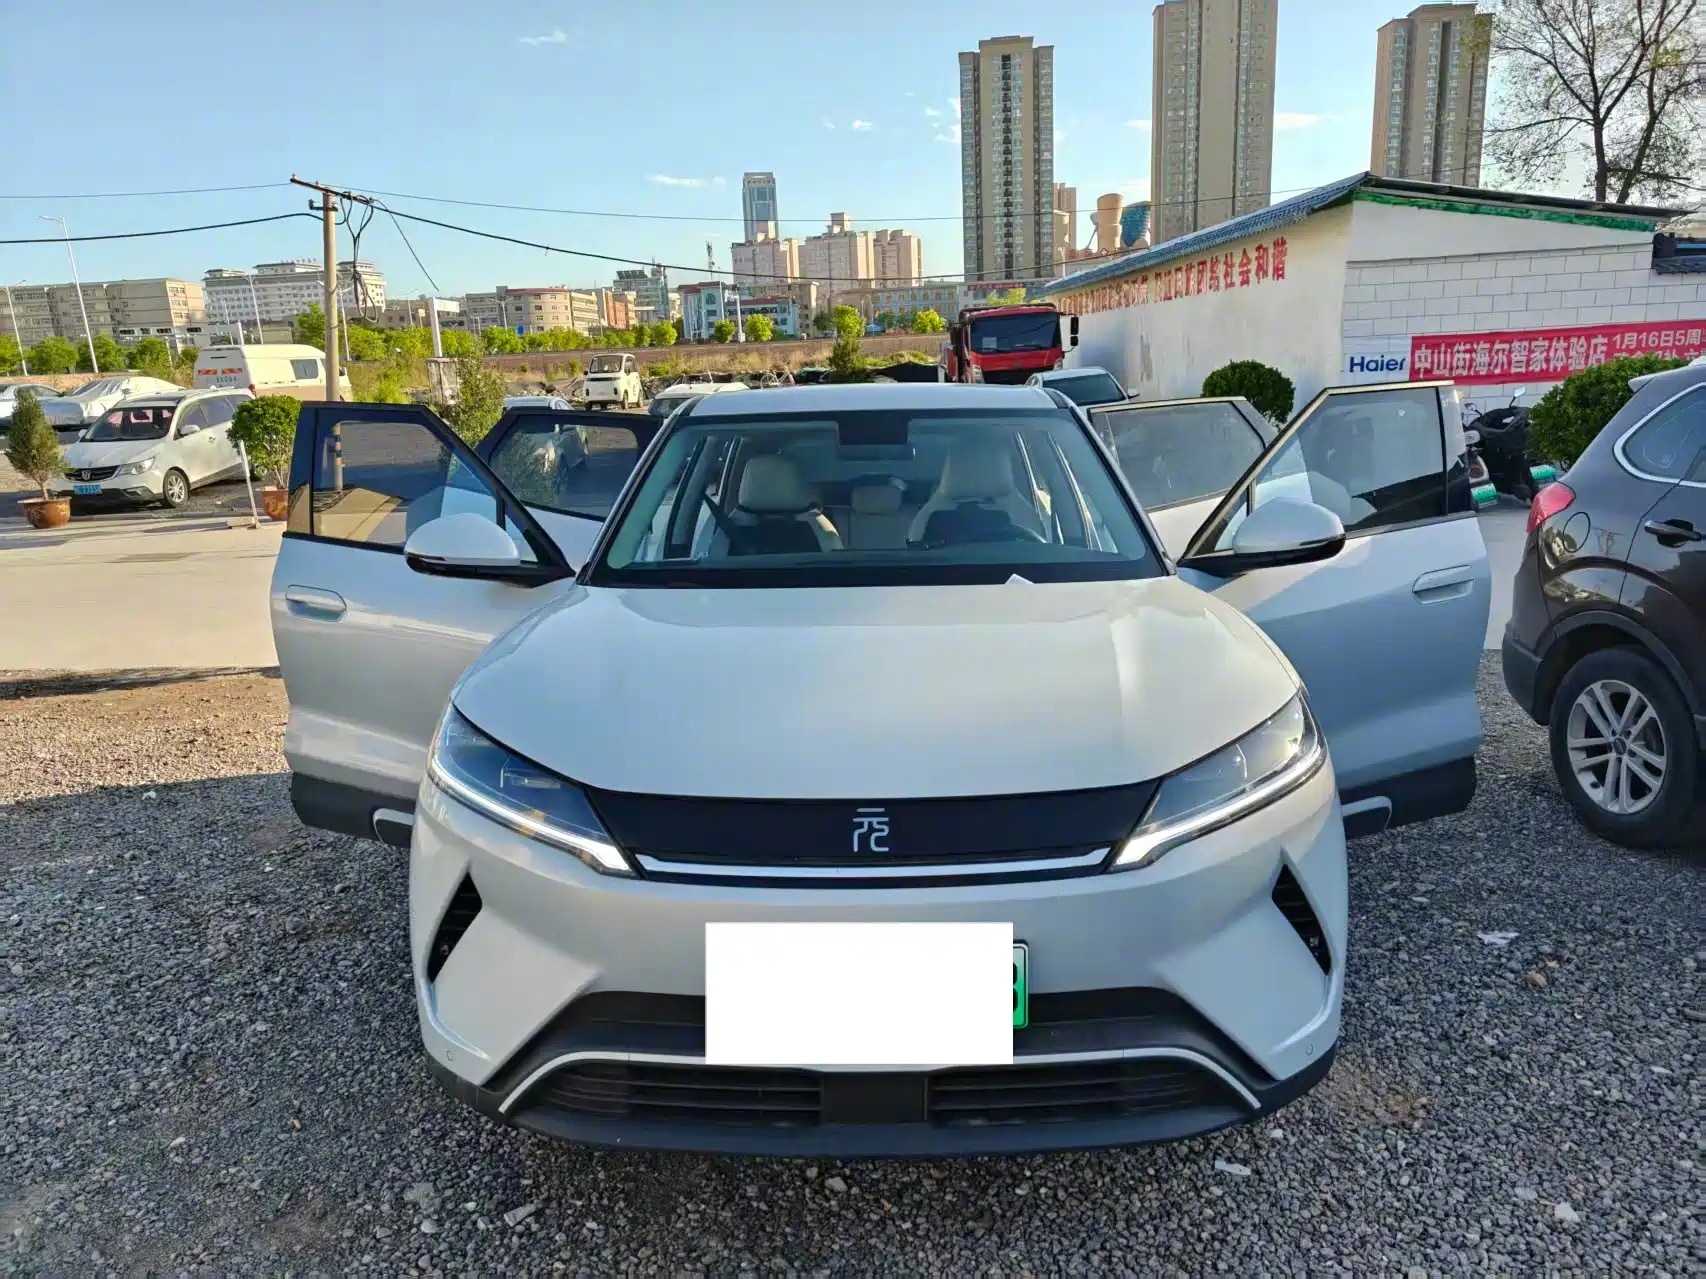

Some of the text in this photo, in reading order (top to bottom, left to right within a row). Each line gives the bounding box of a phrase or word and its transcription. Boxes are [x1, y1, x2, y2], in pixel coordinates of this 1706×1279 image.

[1612, 328, 1706, 349] 1月16日5周
[1349, 354, 1406, 373] Haier
[1414, 334, 1609, 379] 中山街海尔智家体验店
